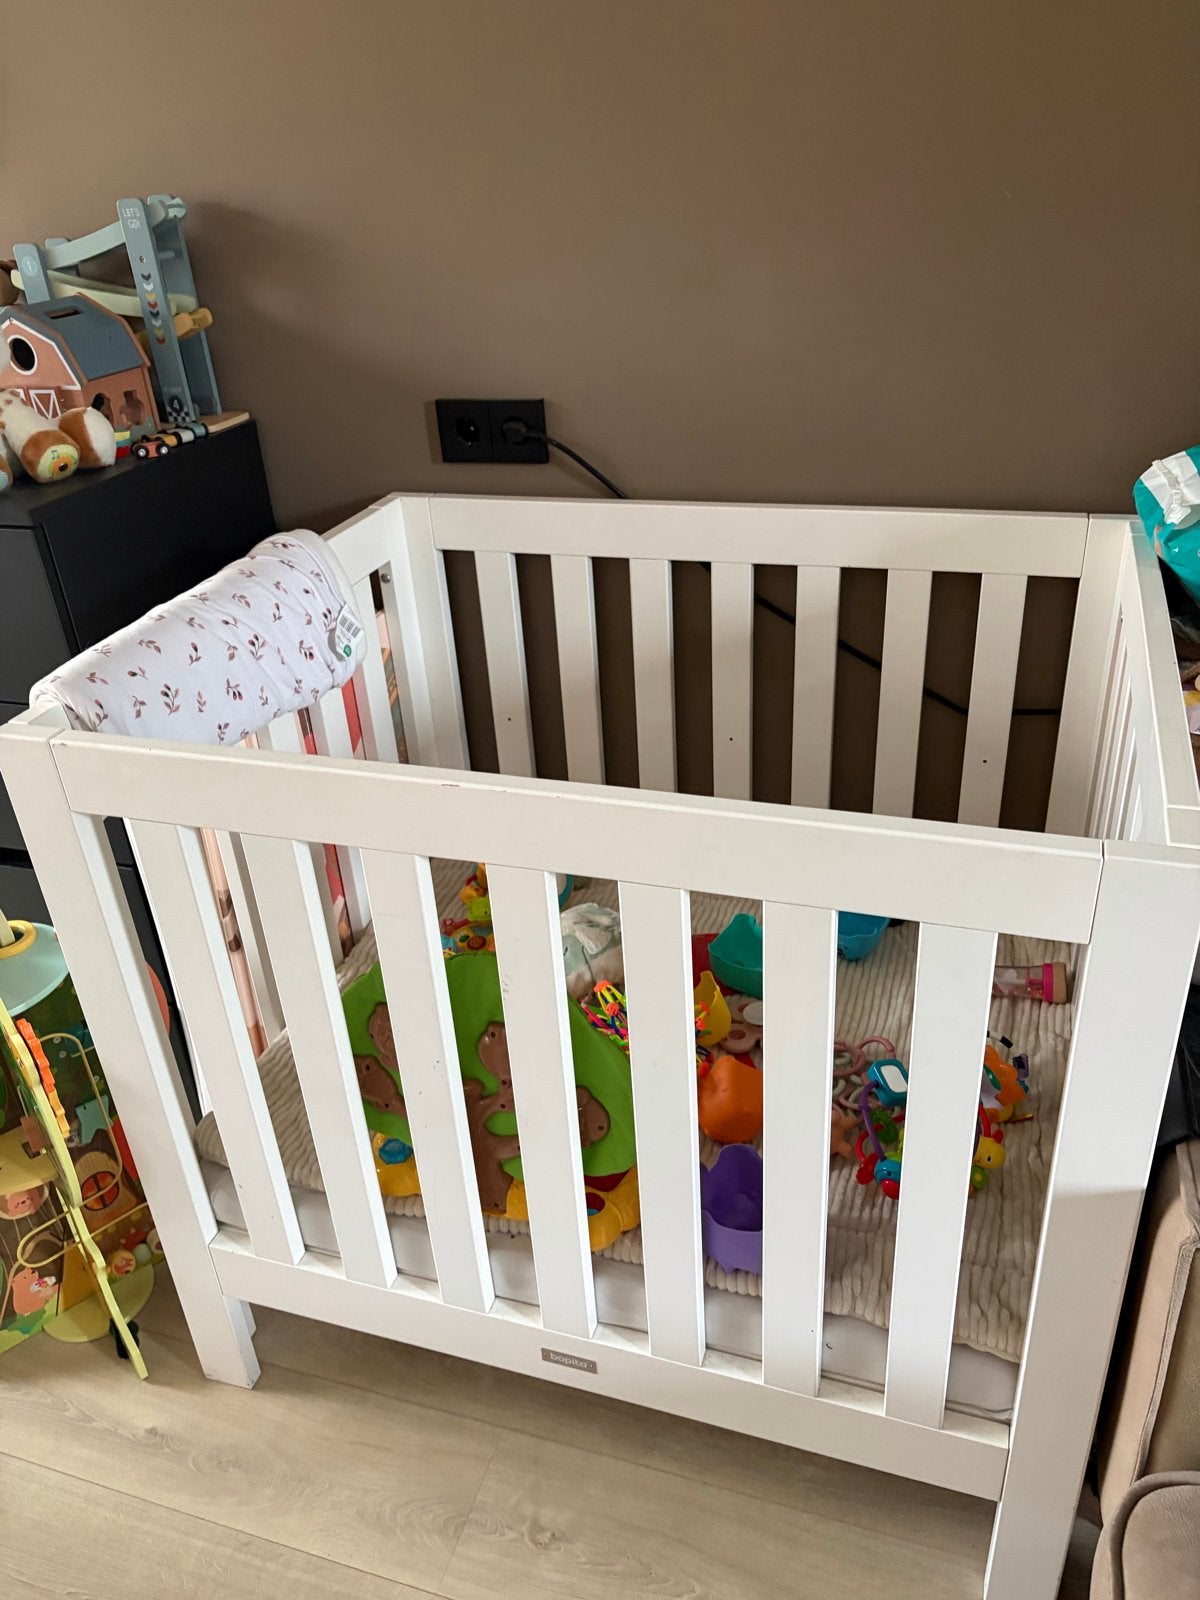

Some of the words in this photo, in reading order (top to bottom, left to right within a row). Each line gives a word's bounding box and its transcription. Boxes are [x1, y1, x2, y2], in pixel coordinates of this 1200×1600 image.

[122, 207, 140, 217] LET'S
[172, 399, 180, 410] 4
[550, 1352, 588, 1368] bopita
